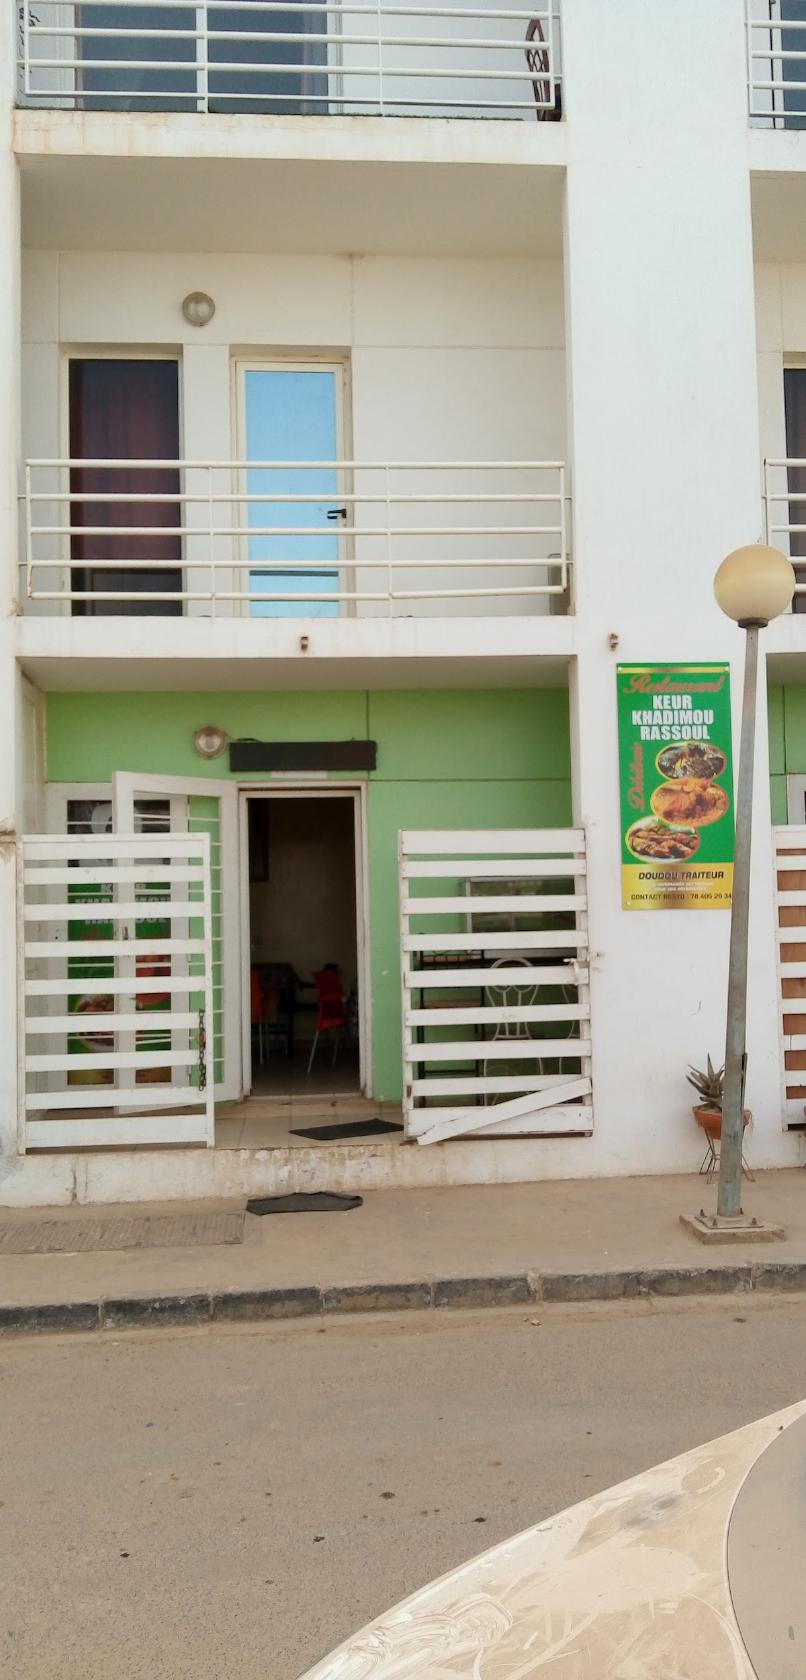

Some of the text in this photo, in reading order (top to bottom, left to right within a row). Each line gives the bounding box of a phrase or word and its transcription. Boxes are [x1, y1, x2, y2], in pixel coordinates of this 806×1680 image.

[652, 694, 692, 709] KEUR
[631, 709, 714, 725] KHADIMOU
[640, 725, 710, 740] RASSOUL
[638, 871, 724, 880] DOUDOU TRAITEUR
